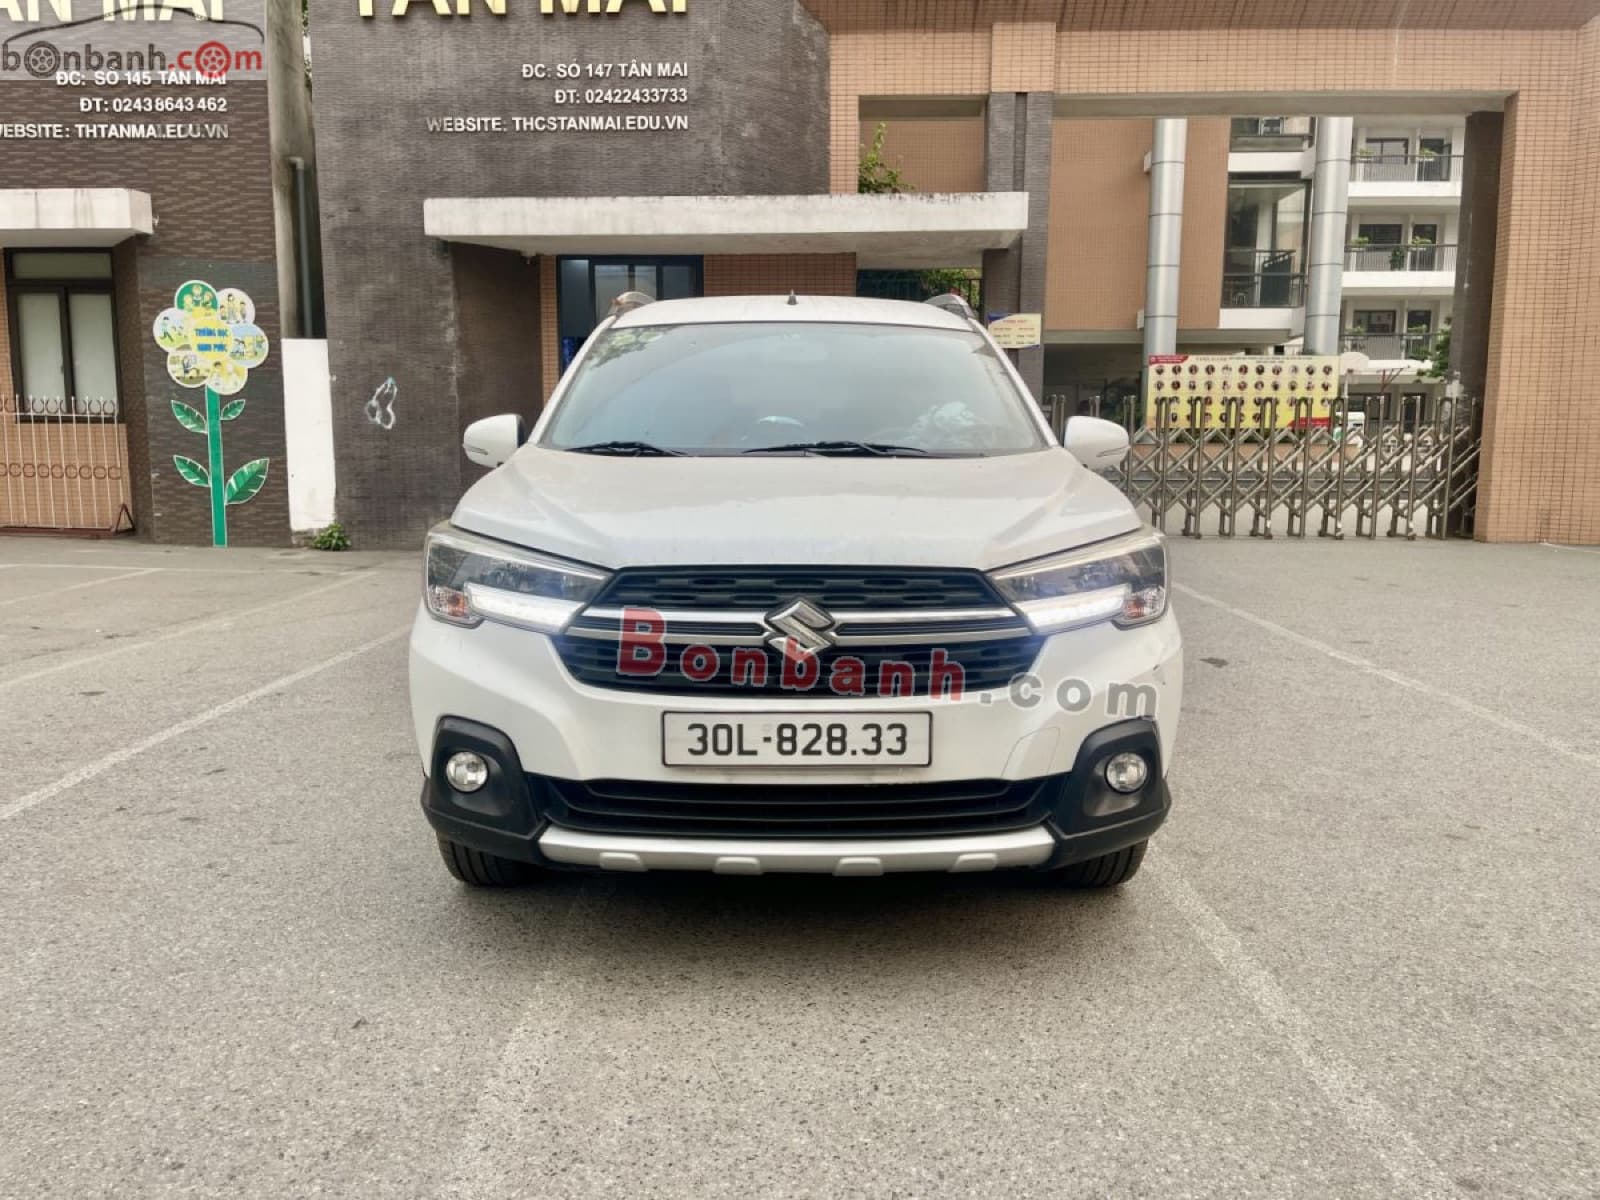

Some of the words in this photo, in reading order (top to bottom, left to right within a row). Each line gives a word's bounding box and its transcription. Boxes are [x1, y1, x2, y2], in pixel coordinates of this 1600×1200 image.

[522, 63, 551, 78] ĐC:
[585, 63, 613, 78] 147
[618, 58, 652, 78] TÂN
[657, 62, 688, 77] MAI
[56, 71, 86, 86] ĐC:
[124, 71, 151, 86] 145
[195, 71, 227, 86] MAI
[554, 88, 580, 104] ĐT:
[585, 87, 688, 104] 02422433733
[79, 97, 109, 113] ĐT:
[427, 117, 507, 132] WEBSITE:
[512, 115, 689, 132] THCSTANMAI.EDU.VN
[687, 723, 907, 756] 30L-828.33
